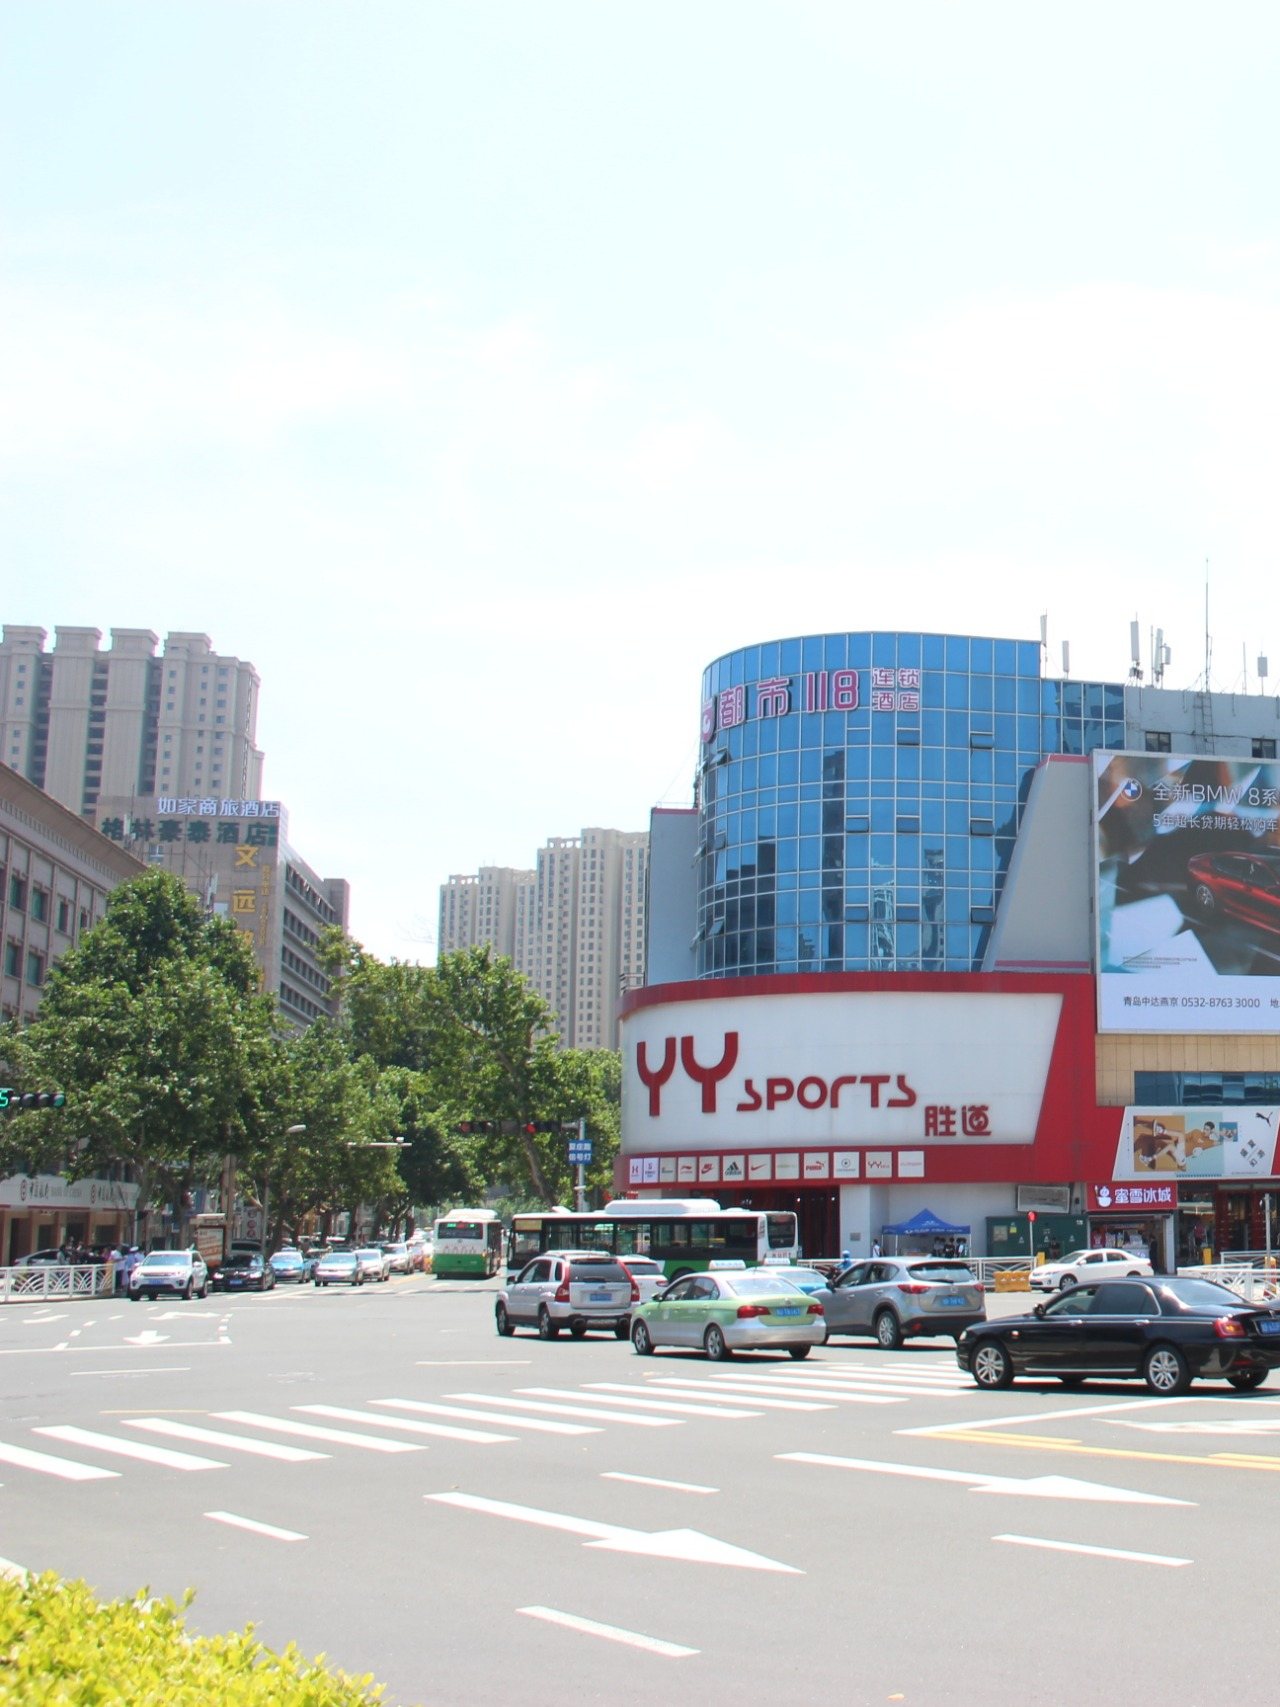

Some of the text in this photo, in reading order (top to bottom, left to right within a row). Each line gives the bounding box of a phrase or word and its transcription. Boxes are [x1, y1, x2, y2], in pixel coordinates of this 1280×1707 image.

[872, 668, 920, 689] 连锁
[872, 690, 920, 712] 酒店
[157, 797, 280, 817] 如家商旅酒店
[924, 1104, 992, 1138] 胜道
[1114, 1187, 1172, 1205] 蜜雪冰城
